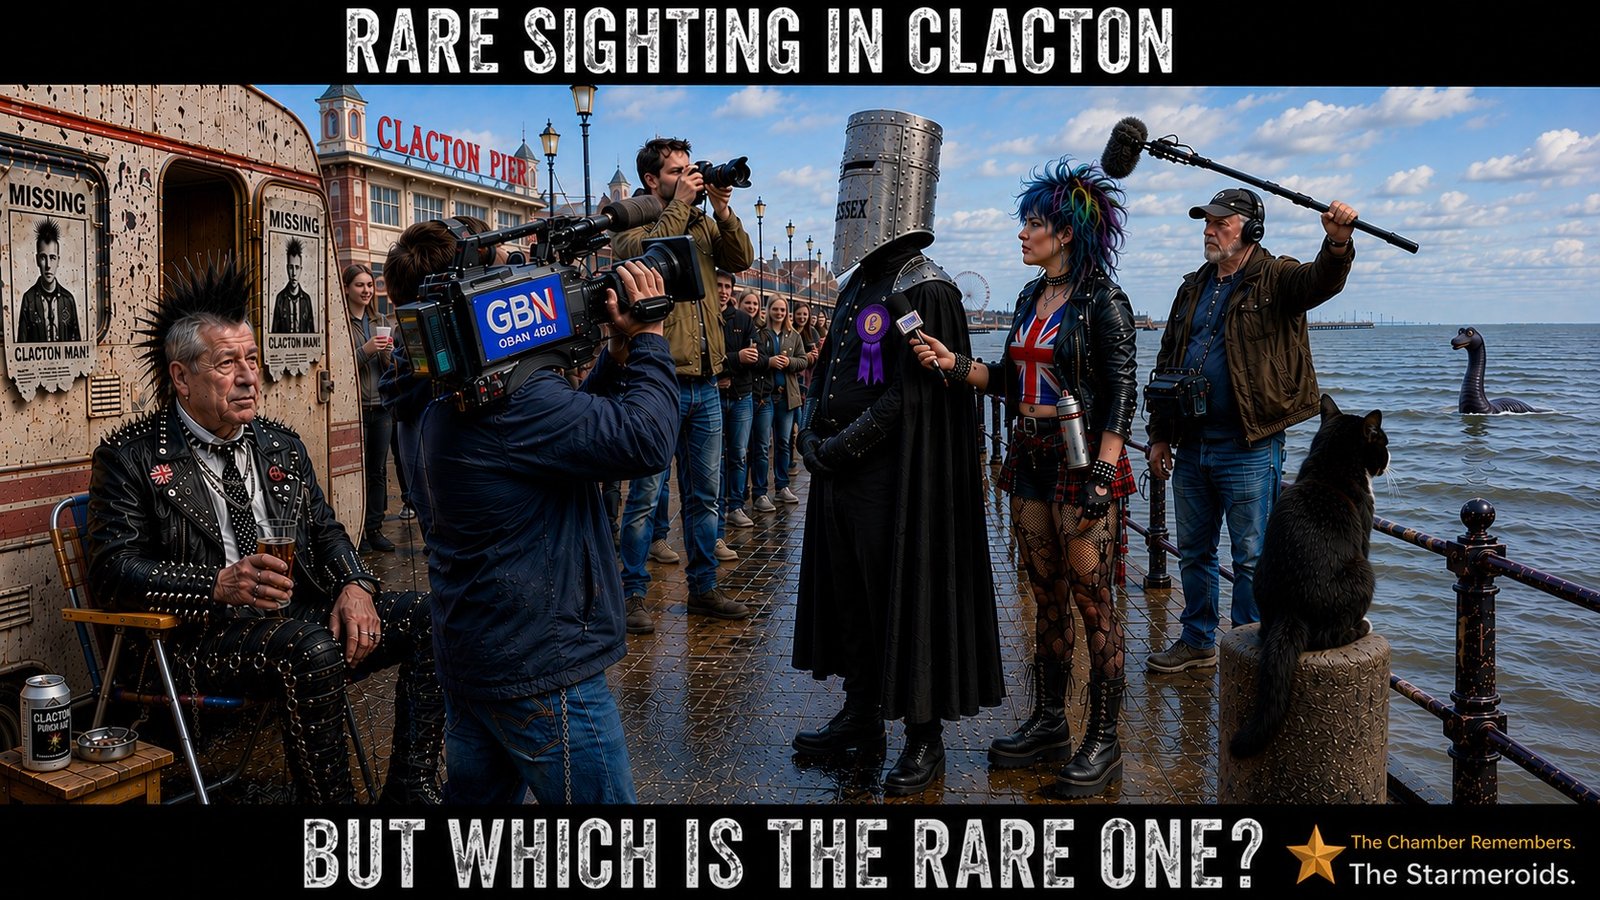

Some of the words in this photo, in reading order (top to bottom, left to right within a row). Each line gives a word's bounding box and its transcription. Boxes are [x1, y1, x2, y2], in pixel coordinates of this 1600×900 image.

[377, 116, 480, 173] CLACTON
[489, 150, 528, 186] PIER
[9, 183, 86, 215] MISSING
[269, 209, 320, 234] MISSING
[486, 287, 557, 334] GBN
[268, 336, 301, 349] CLACTON
[498, 331, 531, 348] OBAN
[15, 346, 61, 361] CLACTON
[64, 345, 90, 359] MAN!
